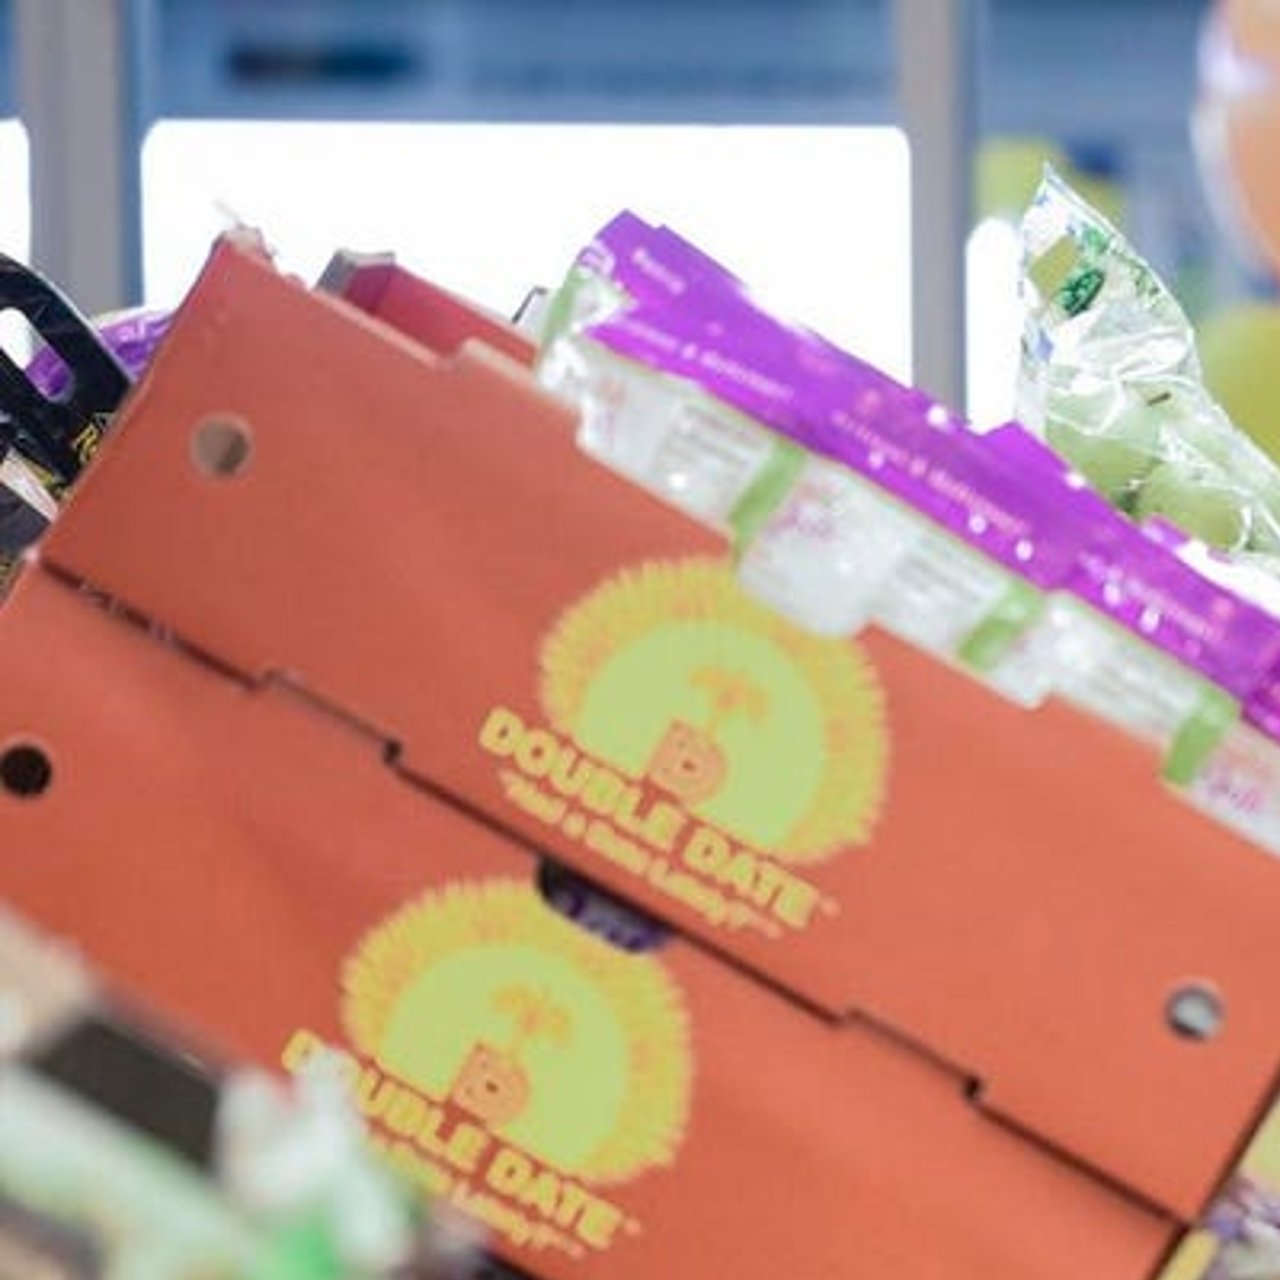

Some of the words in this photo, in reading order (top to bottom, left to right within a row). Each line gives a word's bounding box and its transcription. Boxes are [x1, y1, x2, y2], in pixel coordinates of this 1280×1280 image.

[478, 707, 686, 850] DOUBLE
[683, 828, 820, 931] DATE
[486, 1149, 622, 1251] DATE
